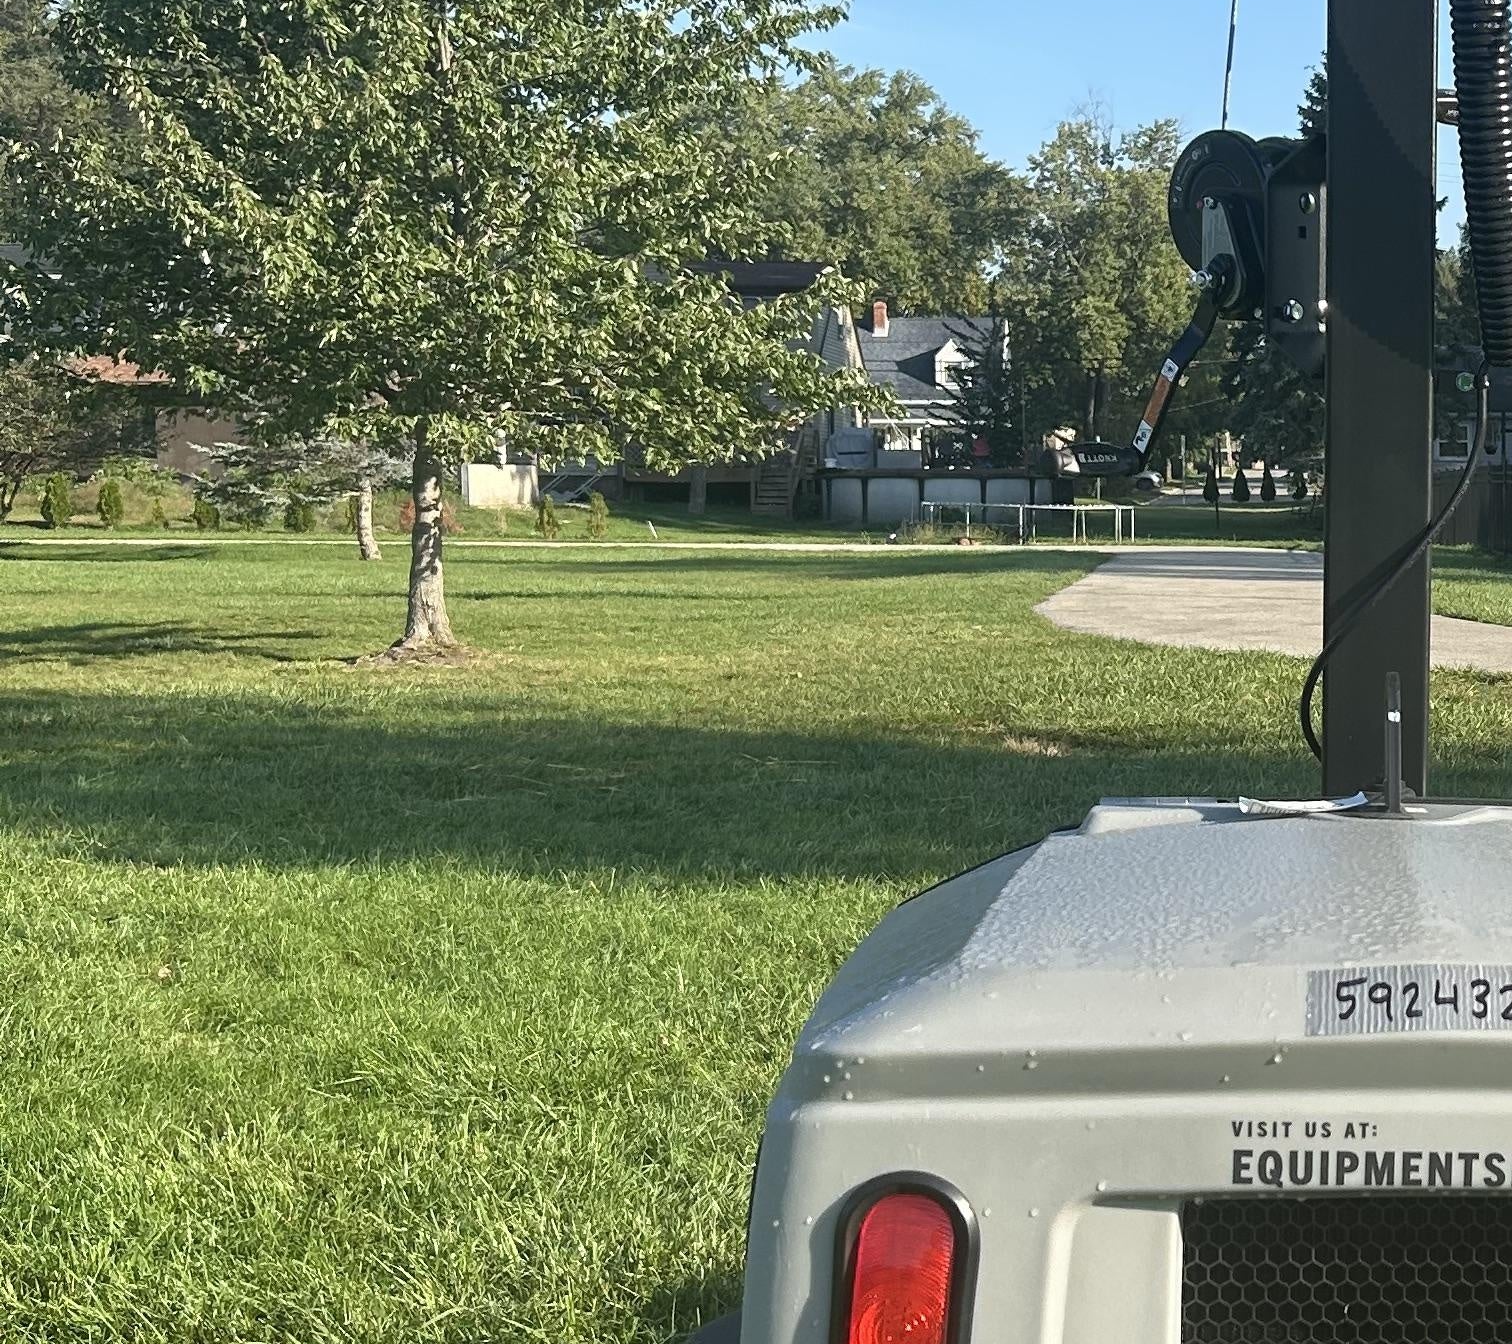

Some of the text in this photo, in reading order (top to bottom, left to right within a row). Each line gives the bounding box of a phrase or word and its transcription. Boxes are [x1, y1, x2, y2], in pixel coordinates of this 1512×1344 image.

[1231, 1121, 1378, 1139] VISIT US AT:
